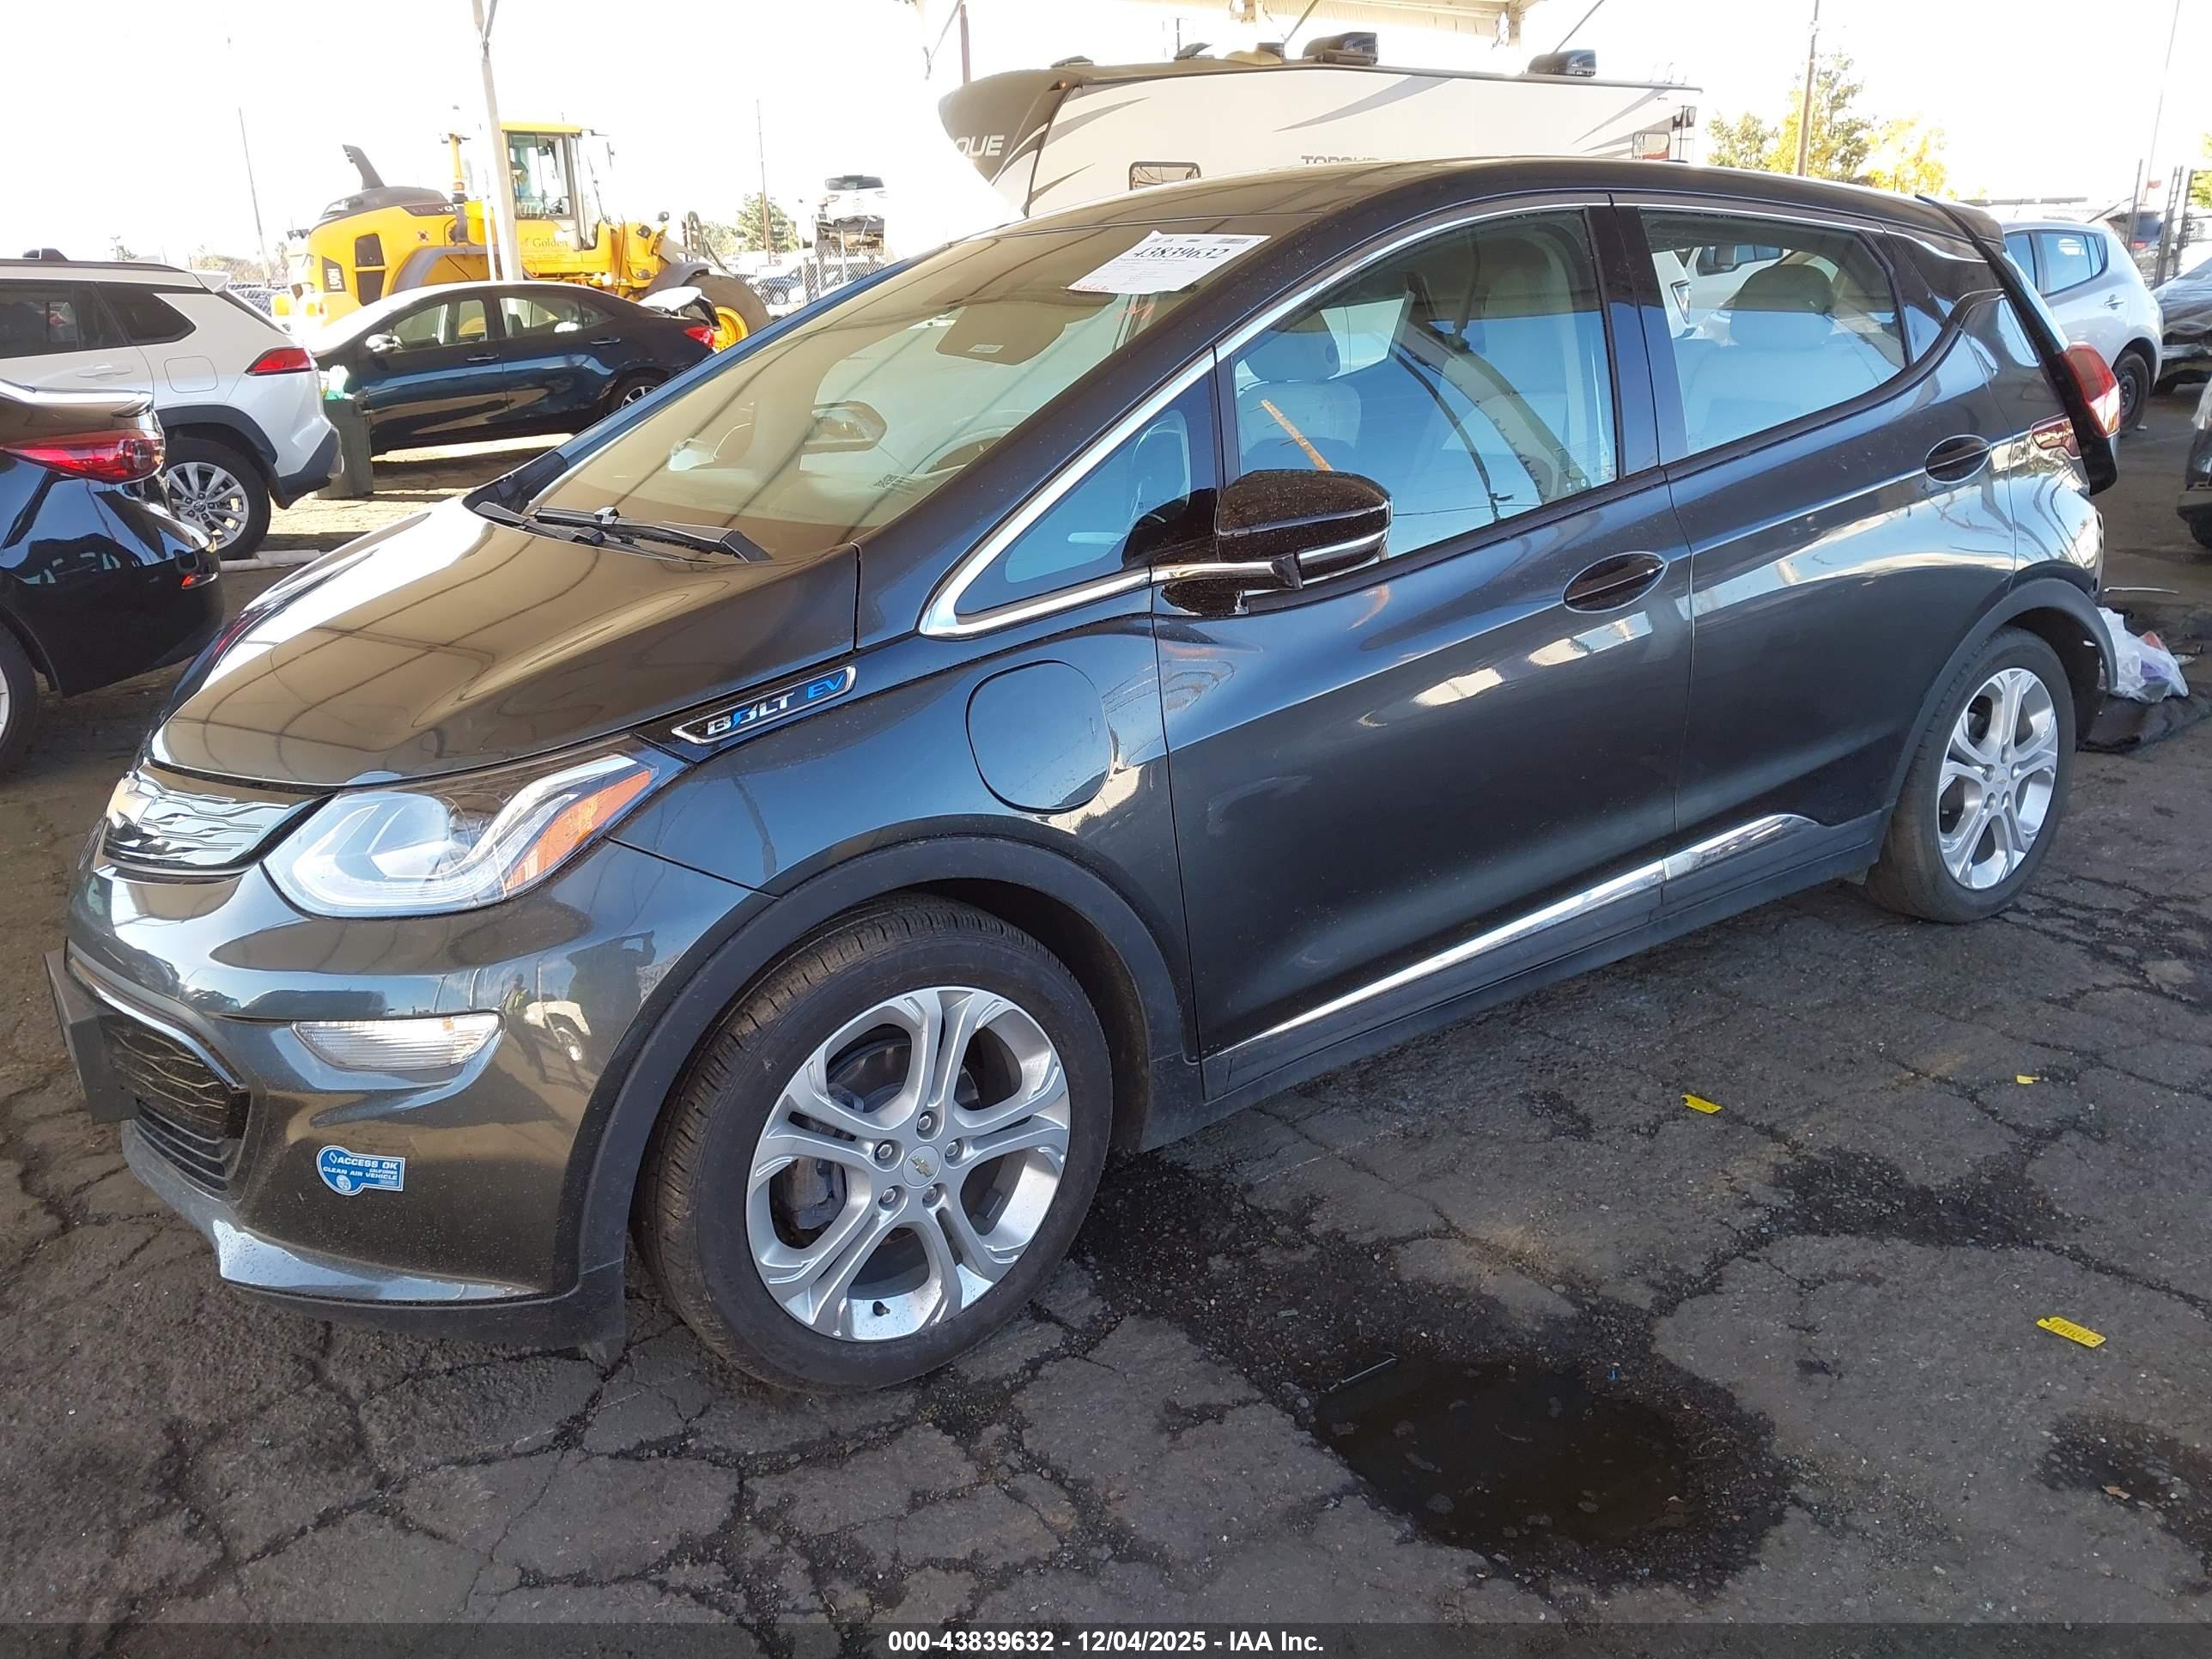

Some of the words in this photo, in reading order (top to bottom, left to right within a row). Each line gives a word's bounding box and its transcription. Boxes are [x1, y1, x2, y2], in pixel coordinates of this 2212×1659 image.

[532, 238, 568, 247] Golden
[1133, 246, 1231, 258] 43839632
[707, 692, 794, 735] BOLT
[807, 673, 845, 700] EV
[337, 1157, 379, 1168] ACCESS
[323, 1166, 348, 1175] CLEAN
[365, 1172, 398, 1181] VEHICLE
